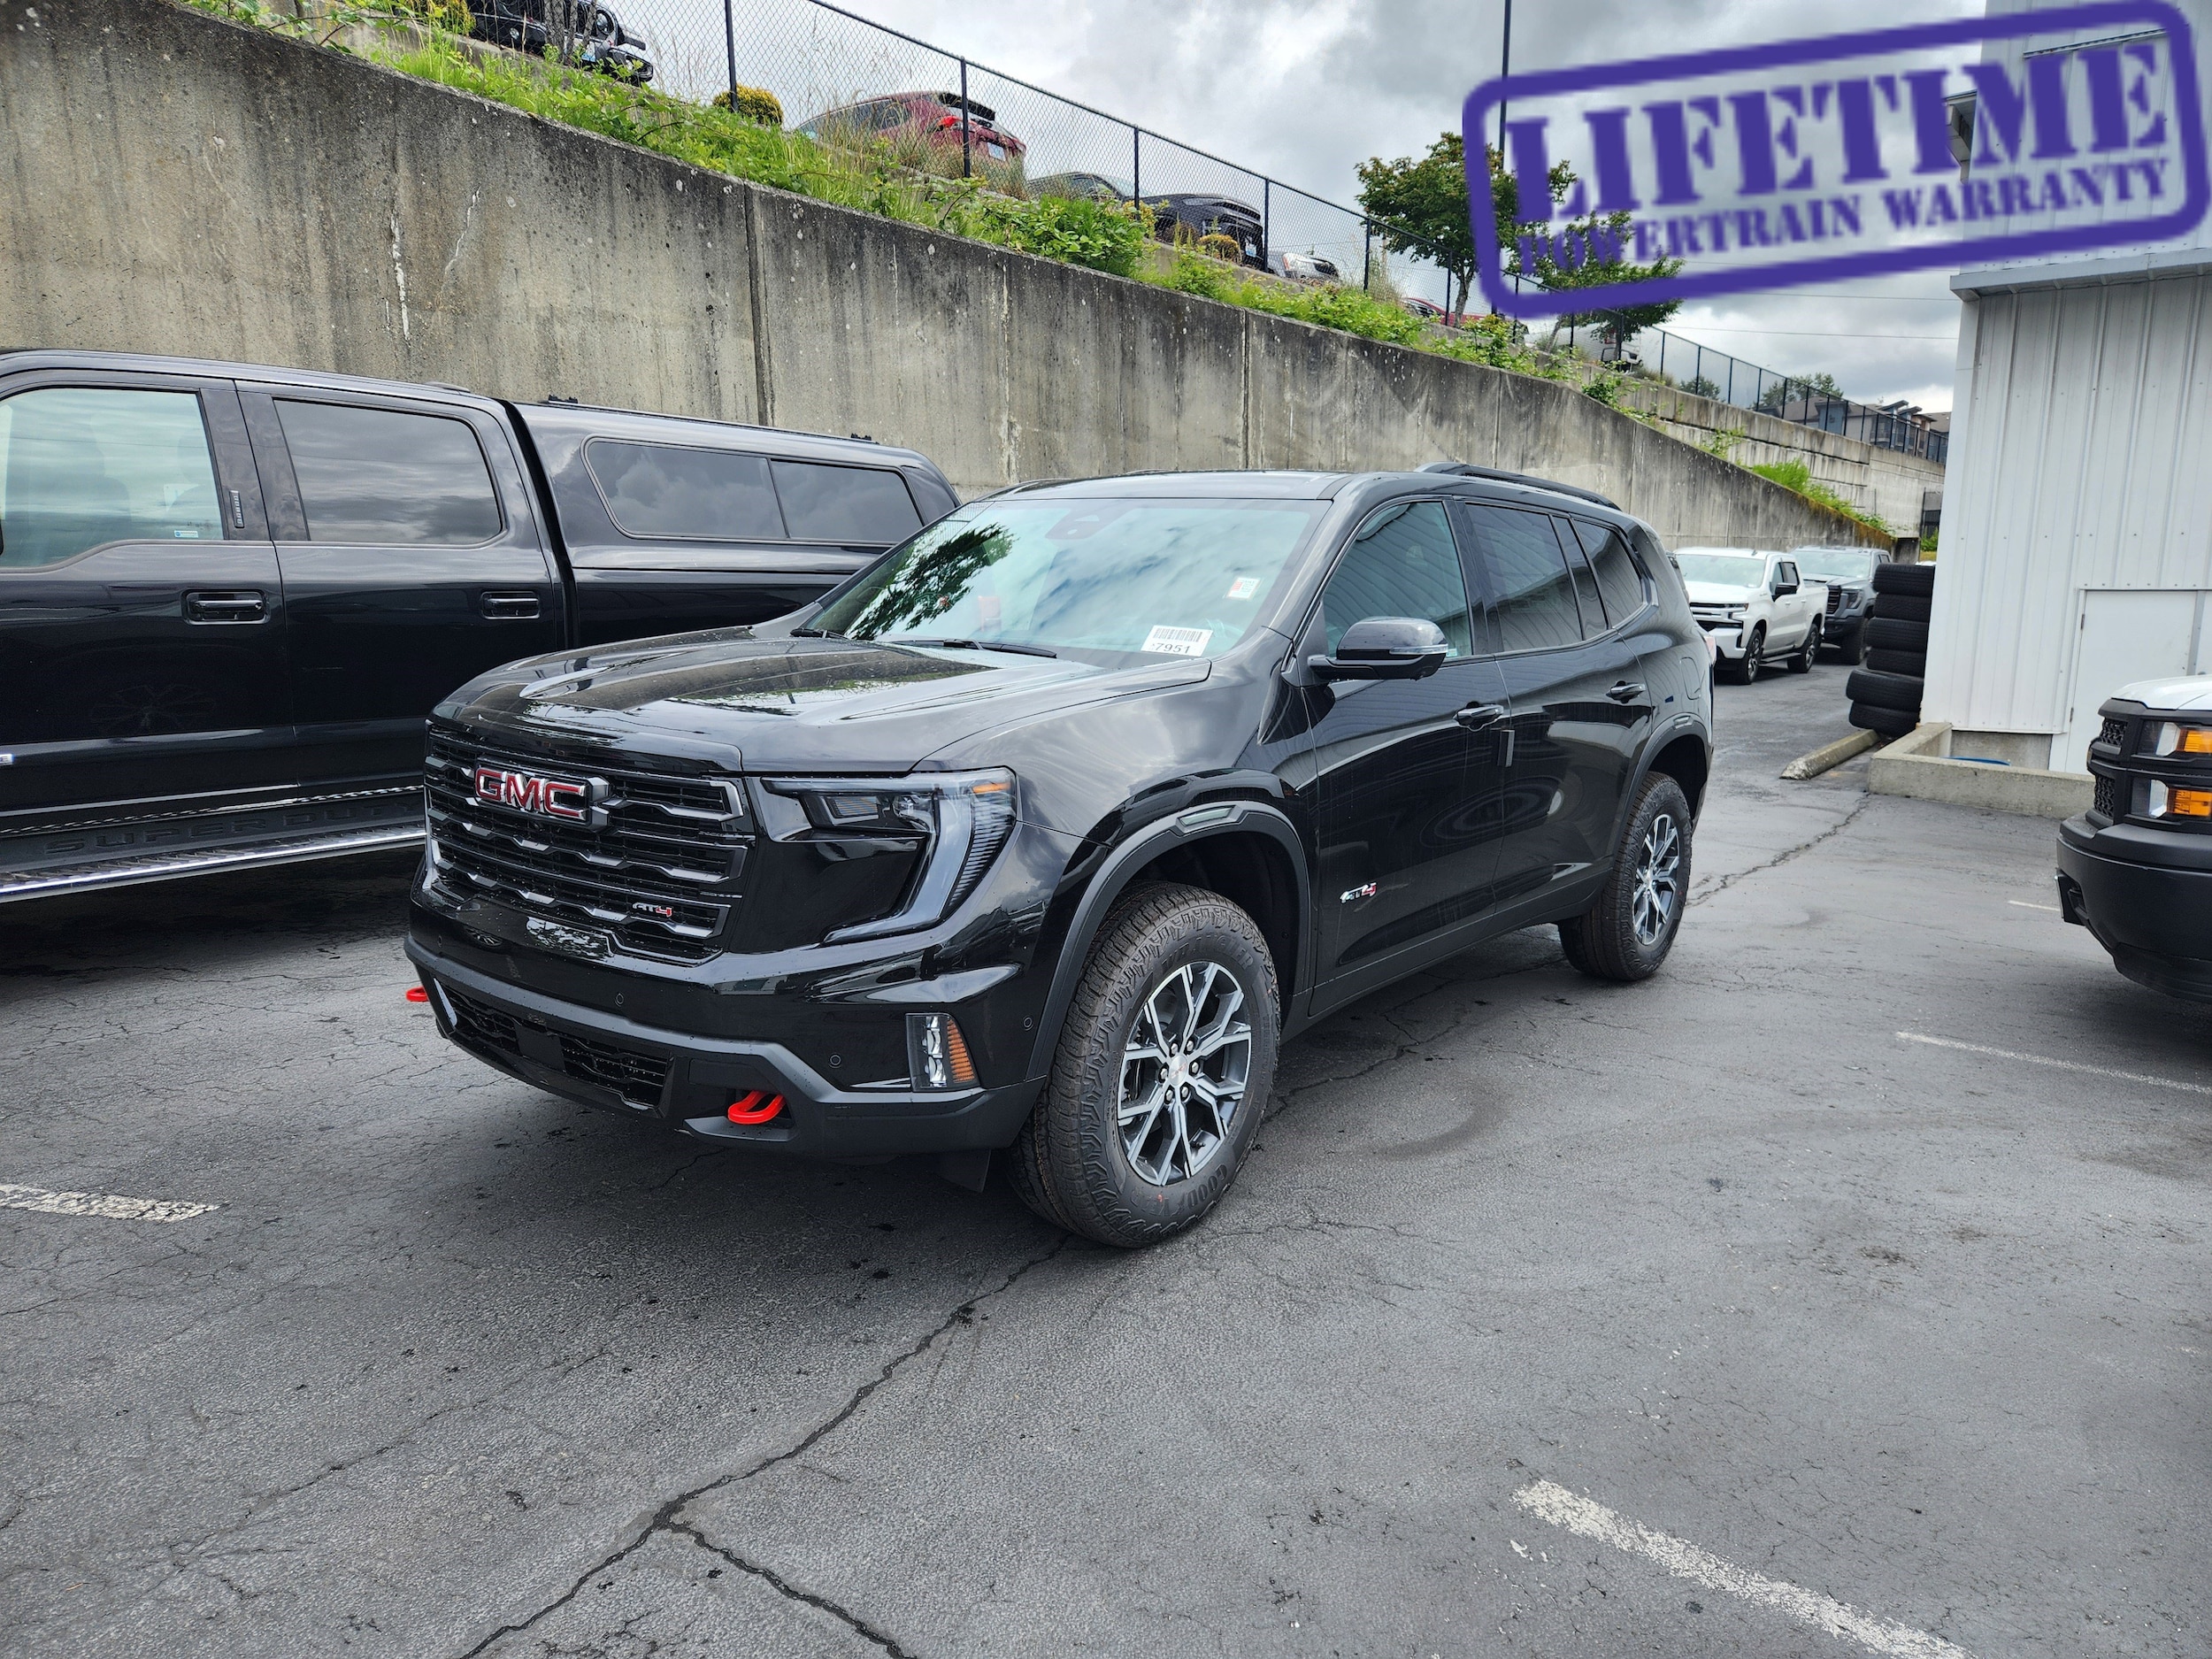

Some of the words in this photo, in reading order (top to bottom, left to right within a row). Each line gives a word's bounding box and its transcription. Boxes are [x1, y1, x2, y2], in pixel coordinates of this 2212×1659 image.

[1155, 642, 1191, 654] 7951
[475, 767, 586, 821] GMC
[44, 818, 268, 856] SUPER
[281, 800, 423, 827] DUTY
[1339, 882, 1378, 903] AT4
[631, 902, 672, 918] AT4
